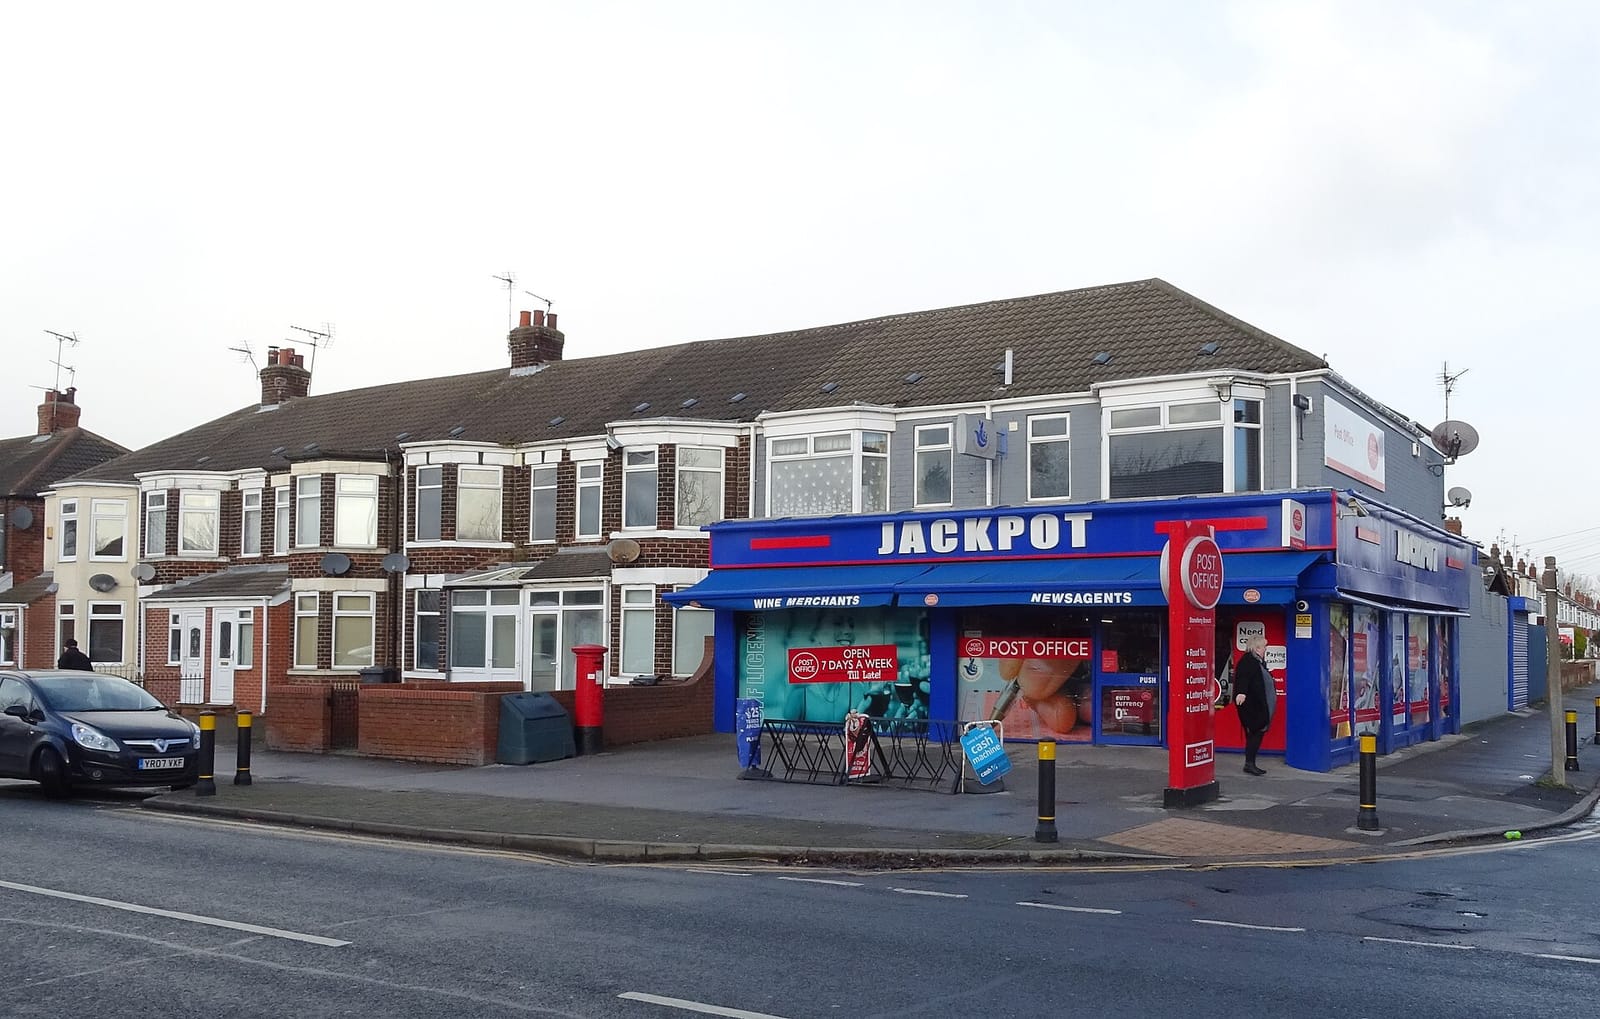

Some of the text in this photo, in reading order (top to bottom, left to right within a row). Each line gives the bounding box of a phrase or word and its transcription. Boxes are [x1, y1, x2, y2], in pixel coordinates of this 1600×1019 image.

[878, 512, 1093, 555] JACKPOT
[1196, 553, 1216, 570] POST
[1192, 572, 1219, 589] OFFICE
[754, 595, 860, 609] WINE MERCHANTS
[1031, 592, 1132, 604] NEWSAGENTS
[1240, 628, 1263, 636] Need
[843, 648, 870, 659] OPEN
[989, 641, 1088, 656] POST OFFICE
[798, 659, 814, 667] POST
[821, 658, 893, 671] 7 DAYS A WEEK
[847, 670, 882, 680] Till Late!
[1139, 676, 1157, 684] PUSH
[971, 735, 994, 754] cash
[972, 744, 1001, 765] machine
[144, 759, 167, 768] YR07
